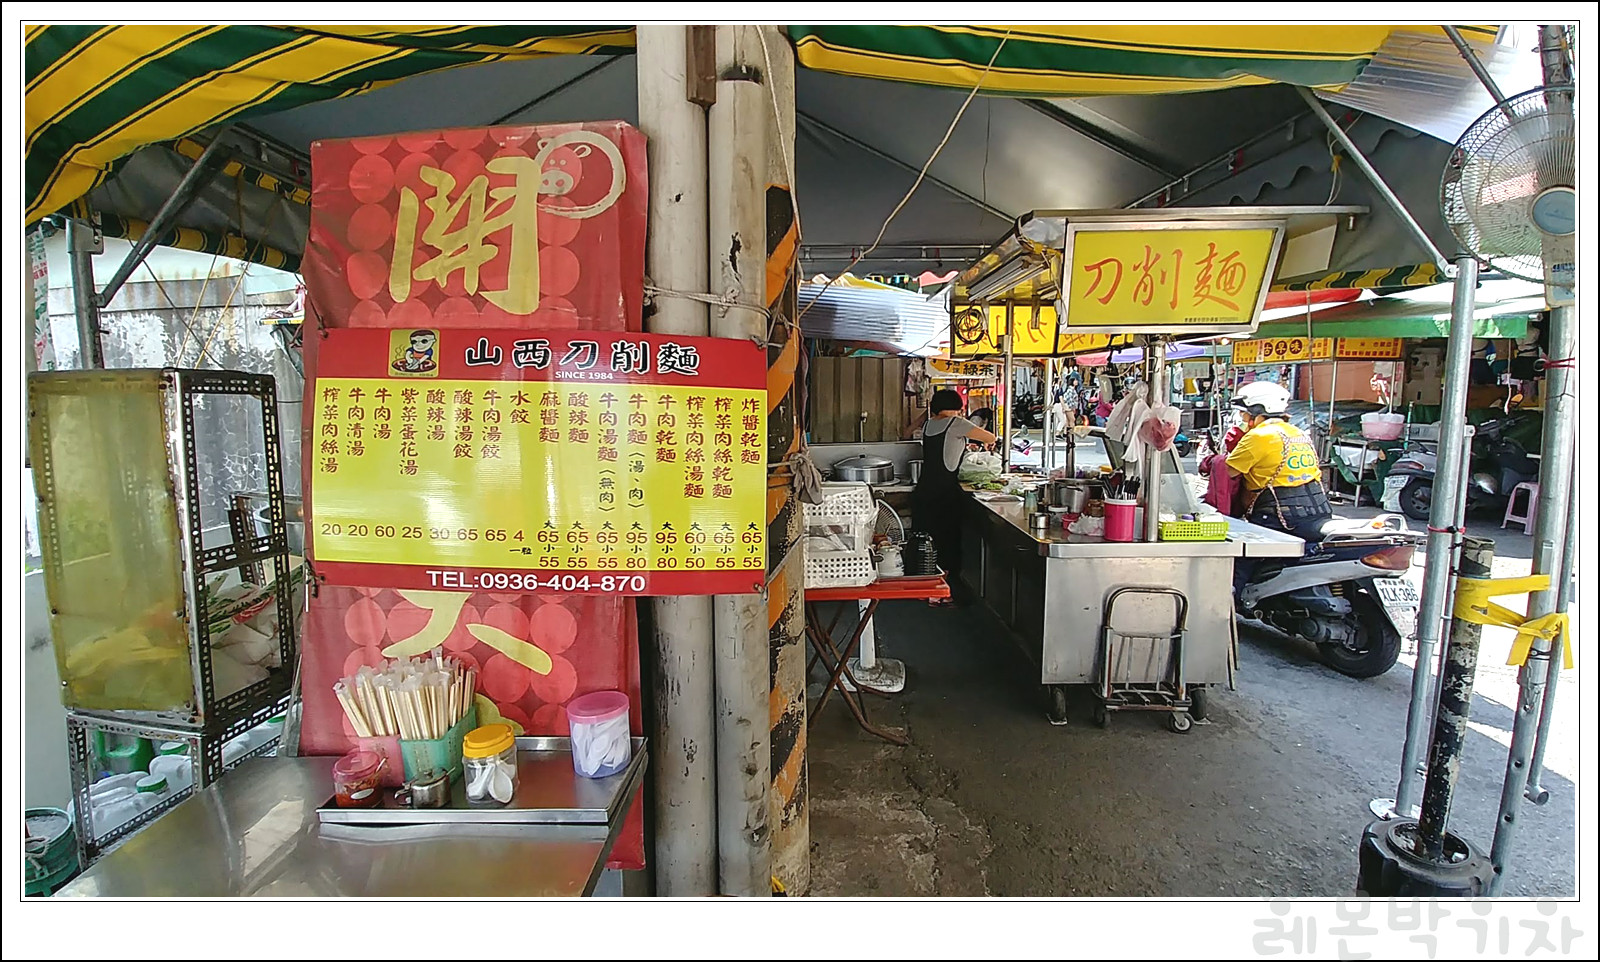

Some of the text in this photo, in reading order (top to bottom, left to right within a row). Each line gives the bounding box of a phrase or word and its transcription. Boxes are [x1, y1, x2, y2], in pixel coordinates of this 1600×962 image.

[1083, 242, 1247, 312] 刀削麵
[465, 337, 700, 376] 山西刀削麵
[555, 371, 613, 380] SINCE 1984
[320, 388, 341, 473] 榨菜肉絲湯
[346, 388, 366, 457] 牛肉清湯
[372, 388, 392, 440] 牛肉湯
[398, 388, 419, 475] 紫菜蛋花湯
[426, 388, 446, 441] 酸辣湯
[453, 388, 474, 459] 酸辣湯餃
[480, 390, 502, 459] 牛肉湯餃
[509, 390, 532, 424] 水餃
[539, 390, 561, 443] 麻醬麵
[568, 392, 589, 444] 酸辣麵
[656, 394, 677, 464] 牛肉乾麵
[740, 398, 762, 464] 炸醬乾麵
[684, 396, 706, 498] 榨菜肉絲湯麵
[712, 397, 734, 498] 榨菜肉絲乾麵
[321, 524, 762, 544] 20 20 60 25 30 65 65 4 65 65 65 95 95 60 65 65
[543, 520, 556, 530] 大
[573, 521, 584, 530] 大
[602, 521, 614, 530] 大
[631, 522, 643, 530] 大
[662, 522, 674, 531] 大
[690, 522, 702, 531] 大
[748, 522, 759, 531] 大
[543, 544, 758, 554] 小 小 小 小 小 小 小 小
[426, 570, 646, 592] TEL:0936-404-870
[539, 556, 762, 568] 55 55 55 80 80 50 55 55
